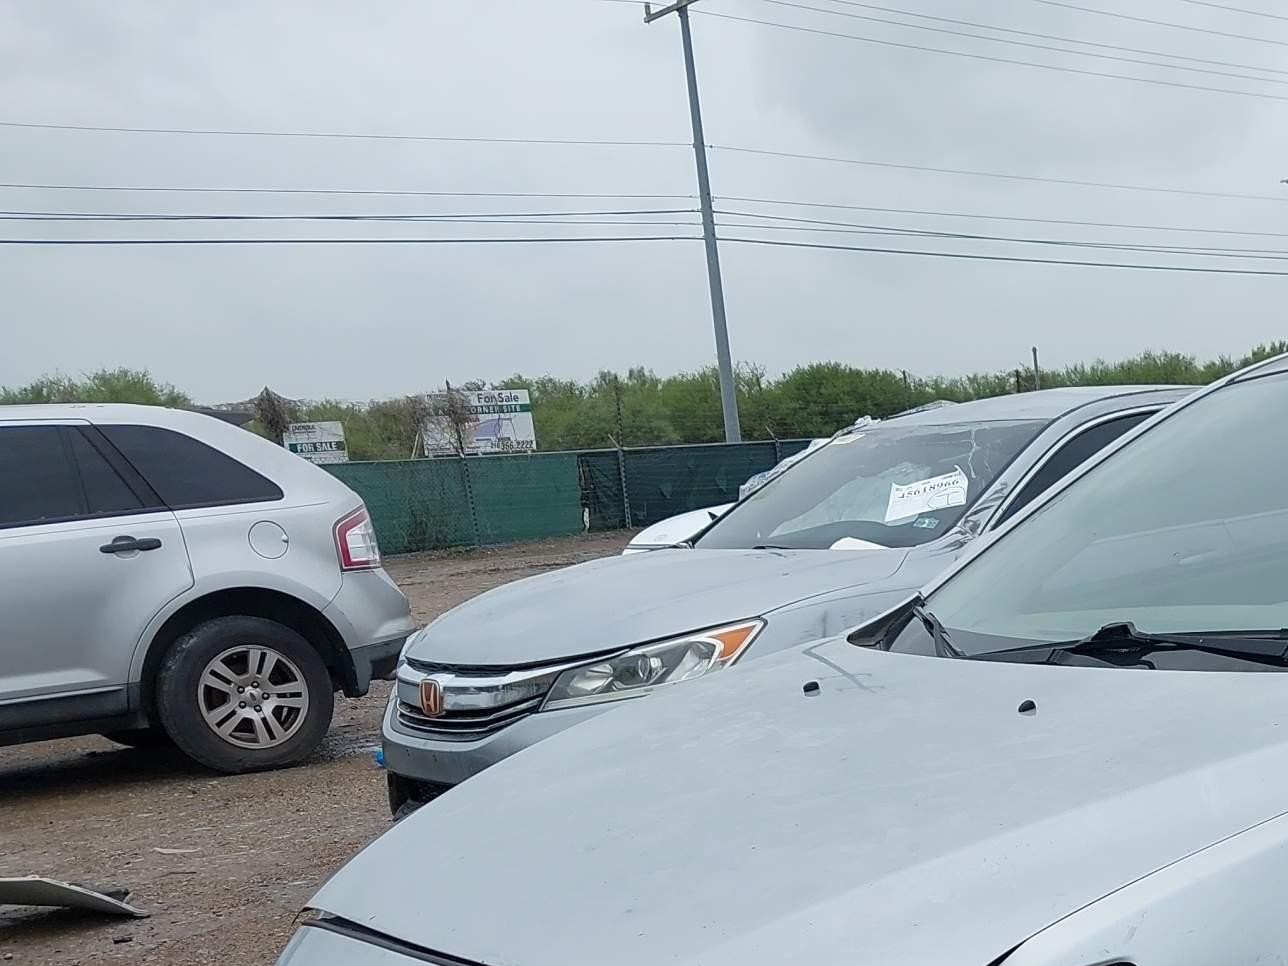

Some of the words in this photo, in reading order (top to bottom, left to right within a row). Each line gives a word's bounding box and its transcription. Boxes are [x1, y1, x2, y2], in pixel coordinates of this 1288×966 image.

[477, 393, 497, 404] For
[497, 391, 520, 403] Sale
[503, 404, 521, 412] SITE
[296, 443, 315, 453] FOR
[315, 441, 338, 452] SALE
